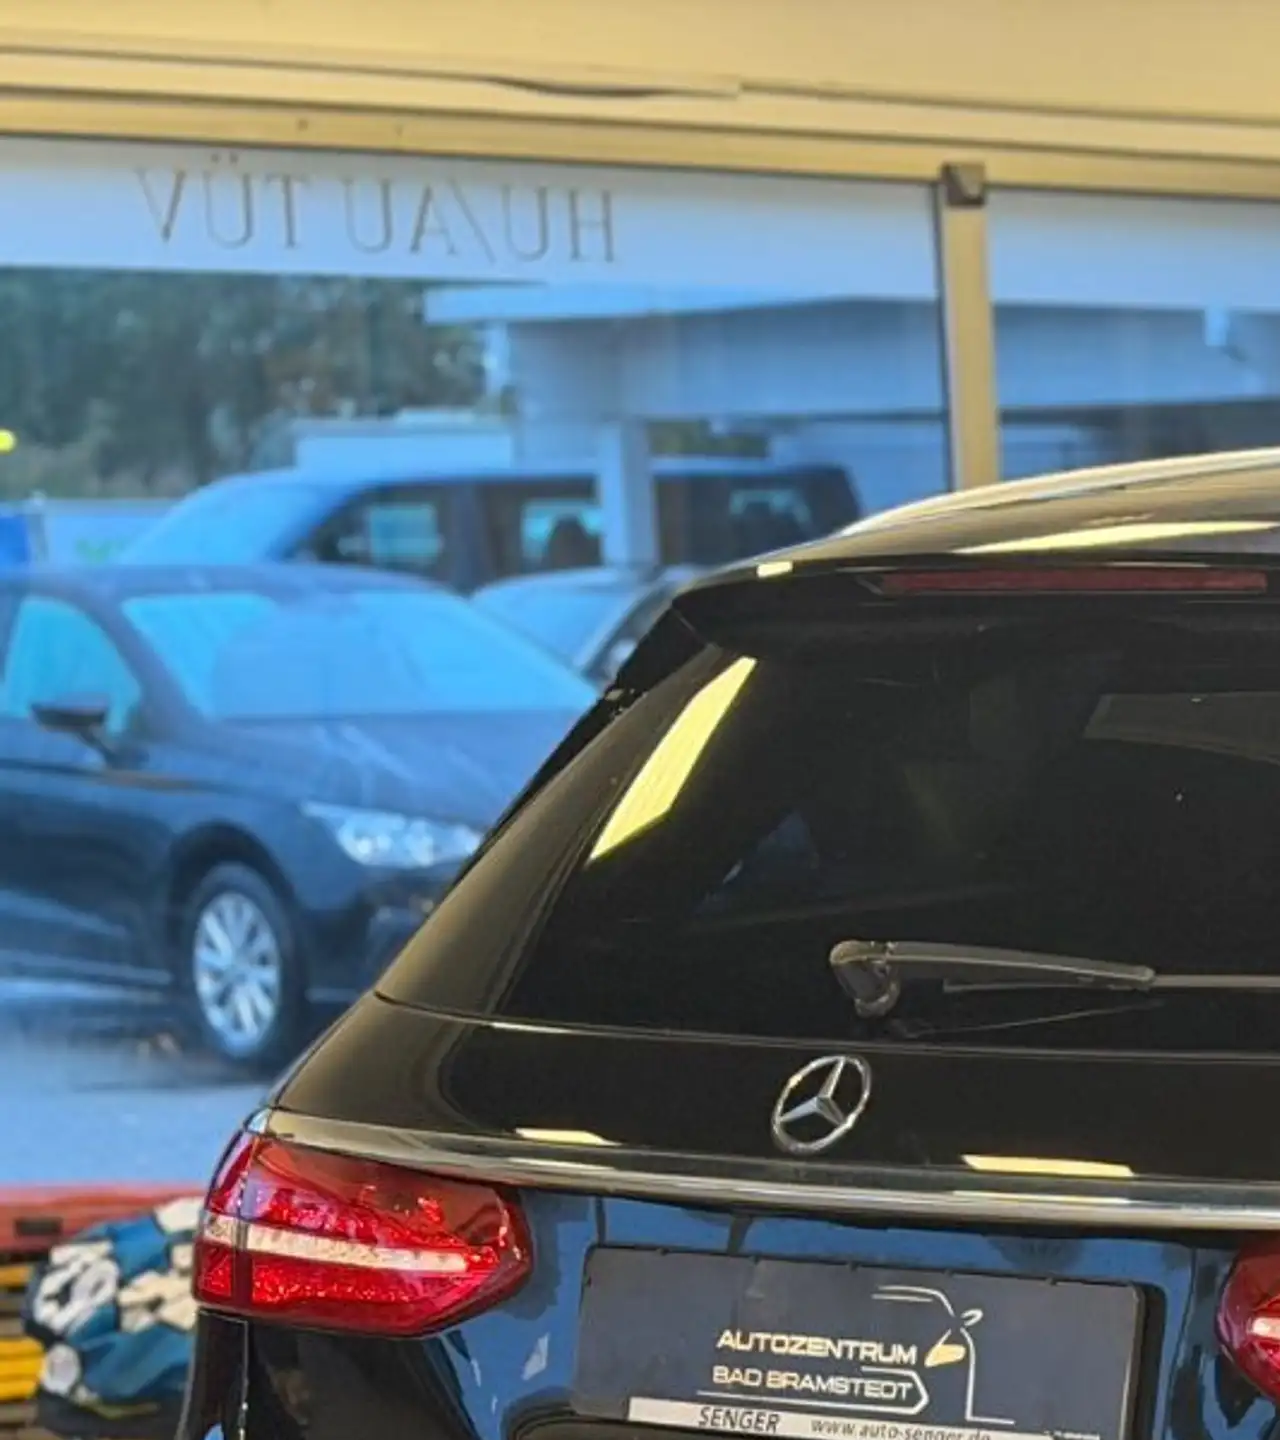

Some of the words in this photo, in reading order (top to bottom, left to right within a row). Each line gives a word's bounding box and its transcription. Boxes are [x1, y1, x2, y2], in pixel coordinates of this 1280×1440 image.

[715, 1327, 918, 1365] AUTOZENTRUM
[711, 1365, 763, 1389] BAD
[767, 1367, 914, 1402] BRAMSTEDT
[697, 1405, 780, 1433] SENGER
